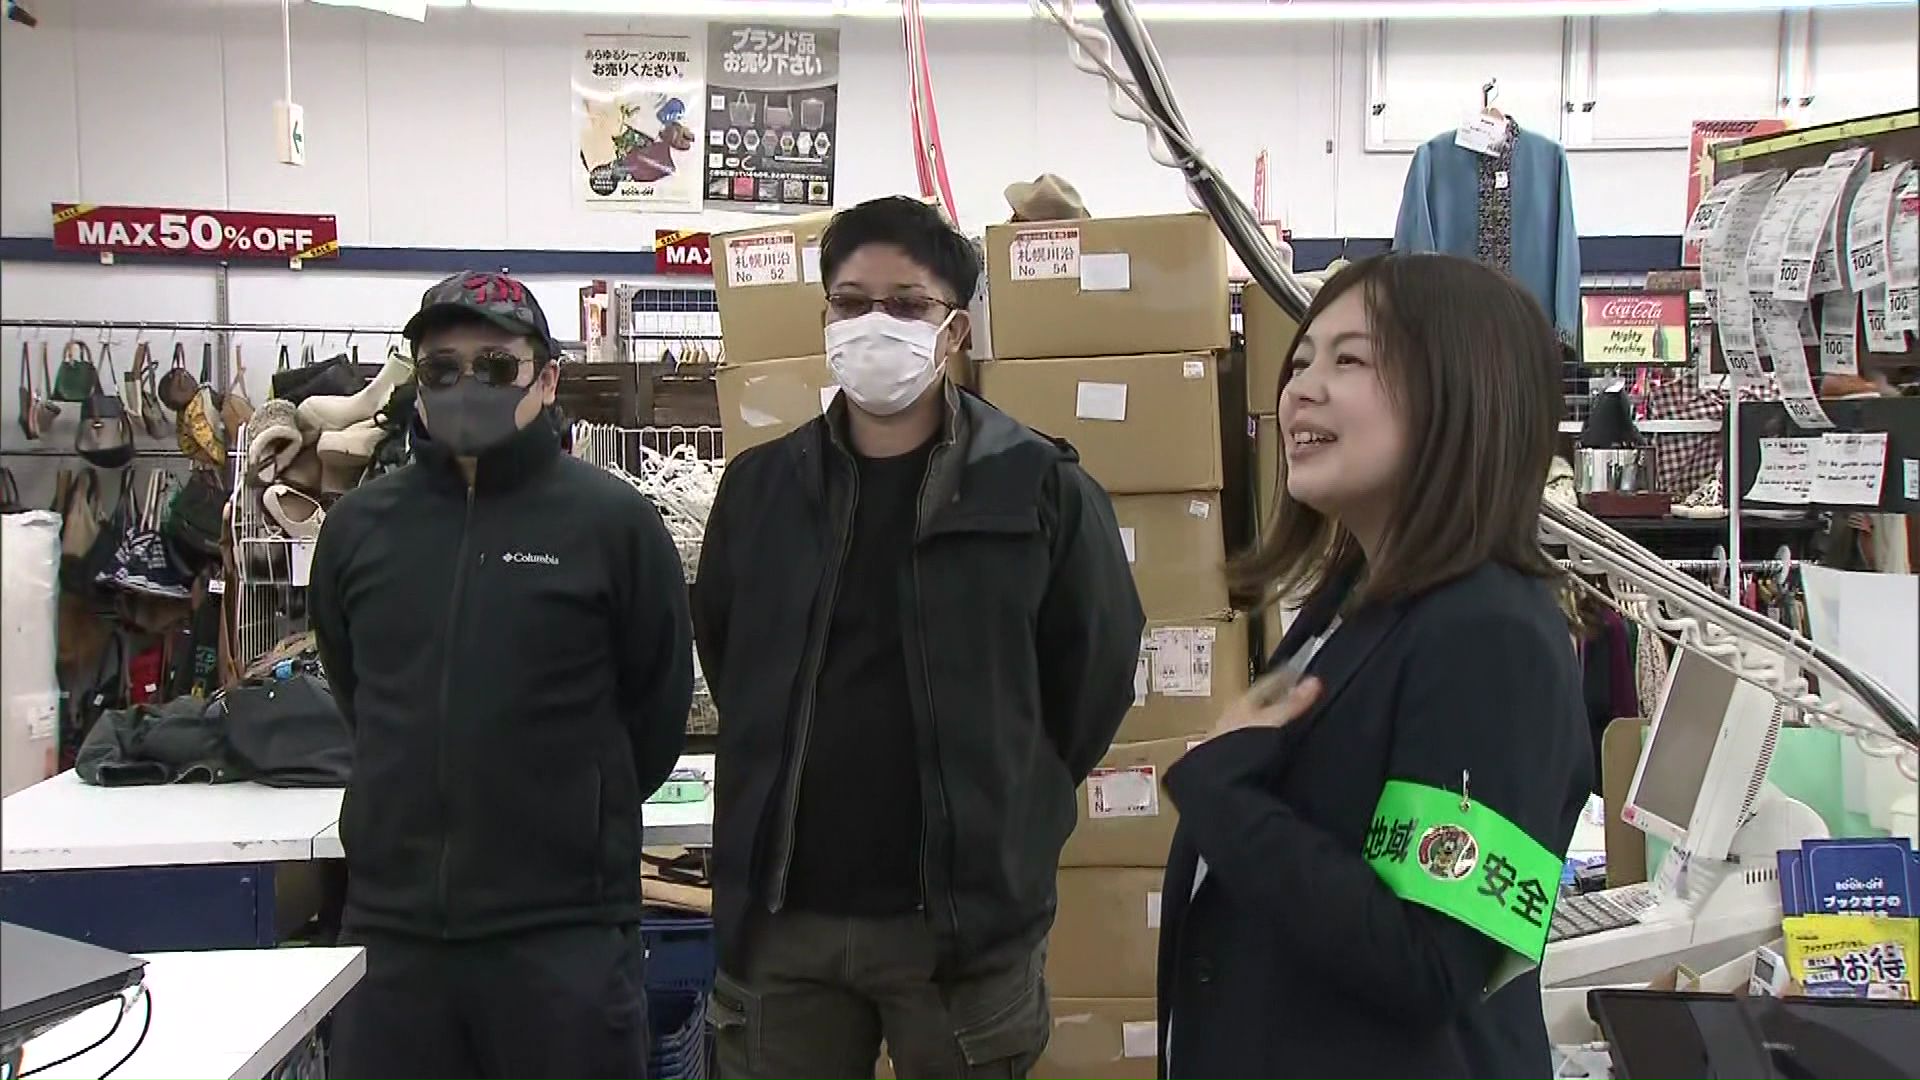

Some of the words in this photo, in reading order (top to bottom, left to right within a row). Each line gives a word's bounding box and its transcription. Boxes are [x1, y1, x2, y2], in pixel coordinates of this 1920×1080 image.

[732, 27, 816, 54] ブランド品
[592, 62, 684, 78] お売りください。
[723, 51, 822, 76] お売り下さい
[660, 232, 681, 245] SALE
[1053, 263, 1067, 274] 54
[1852, 253, 1873, 271] 100
[770, 269, 785, 280] 52
[1780, 266, 1799, 281] 100
[1602, 301, 1663, 319] Coca-Cola
[1889, 296, 1908, 311] 100
[1610, 329, 1643, 343] Mighty
[1603, 342, 1646, 356] refreshing
[1825, 341, 1843, 354] 100
[1729, 357, 1749, 369] 100
[1789, 403, 1810, 417] 100
[513, 552, 560, 565] Columbia
[1477, 852, 1549, 928] 安全
[1823, 895, 1901, 908] ブックオフの
[1844, 944, 1905, 981] お得
